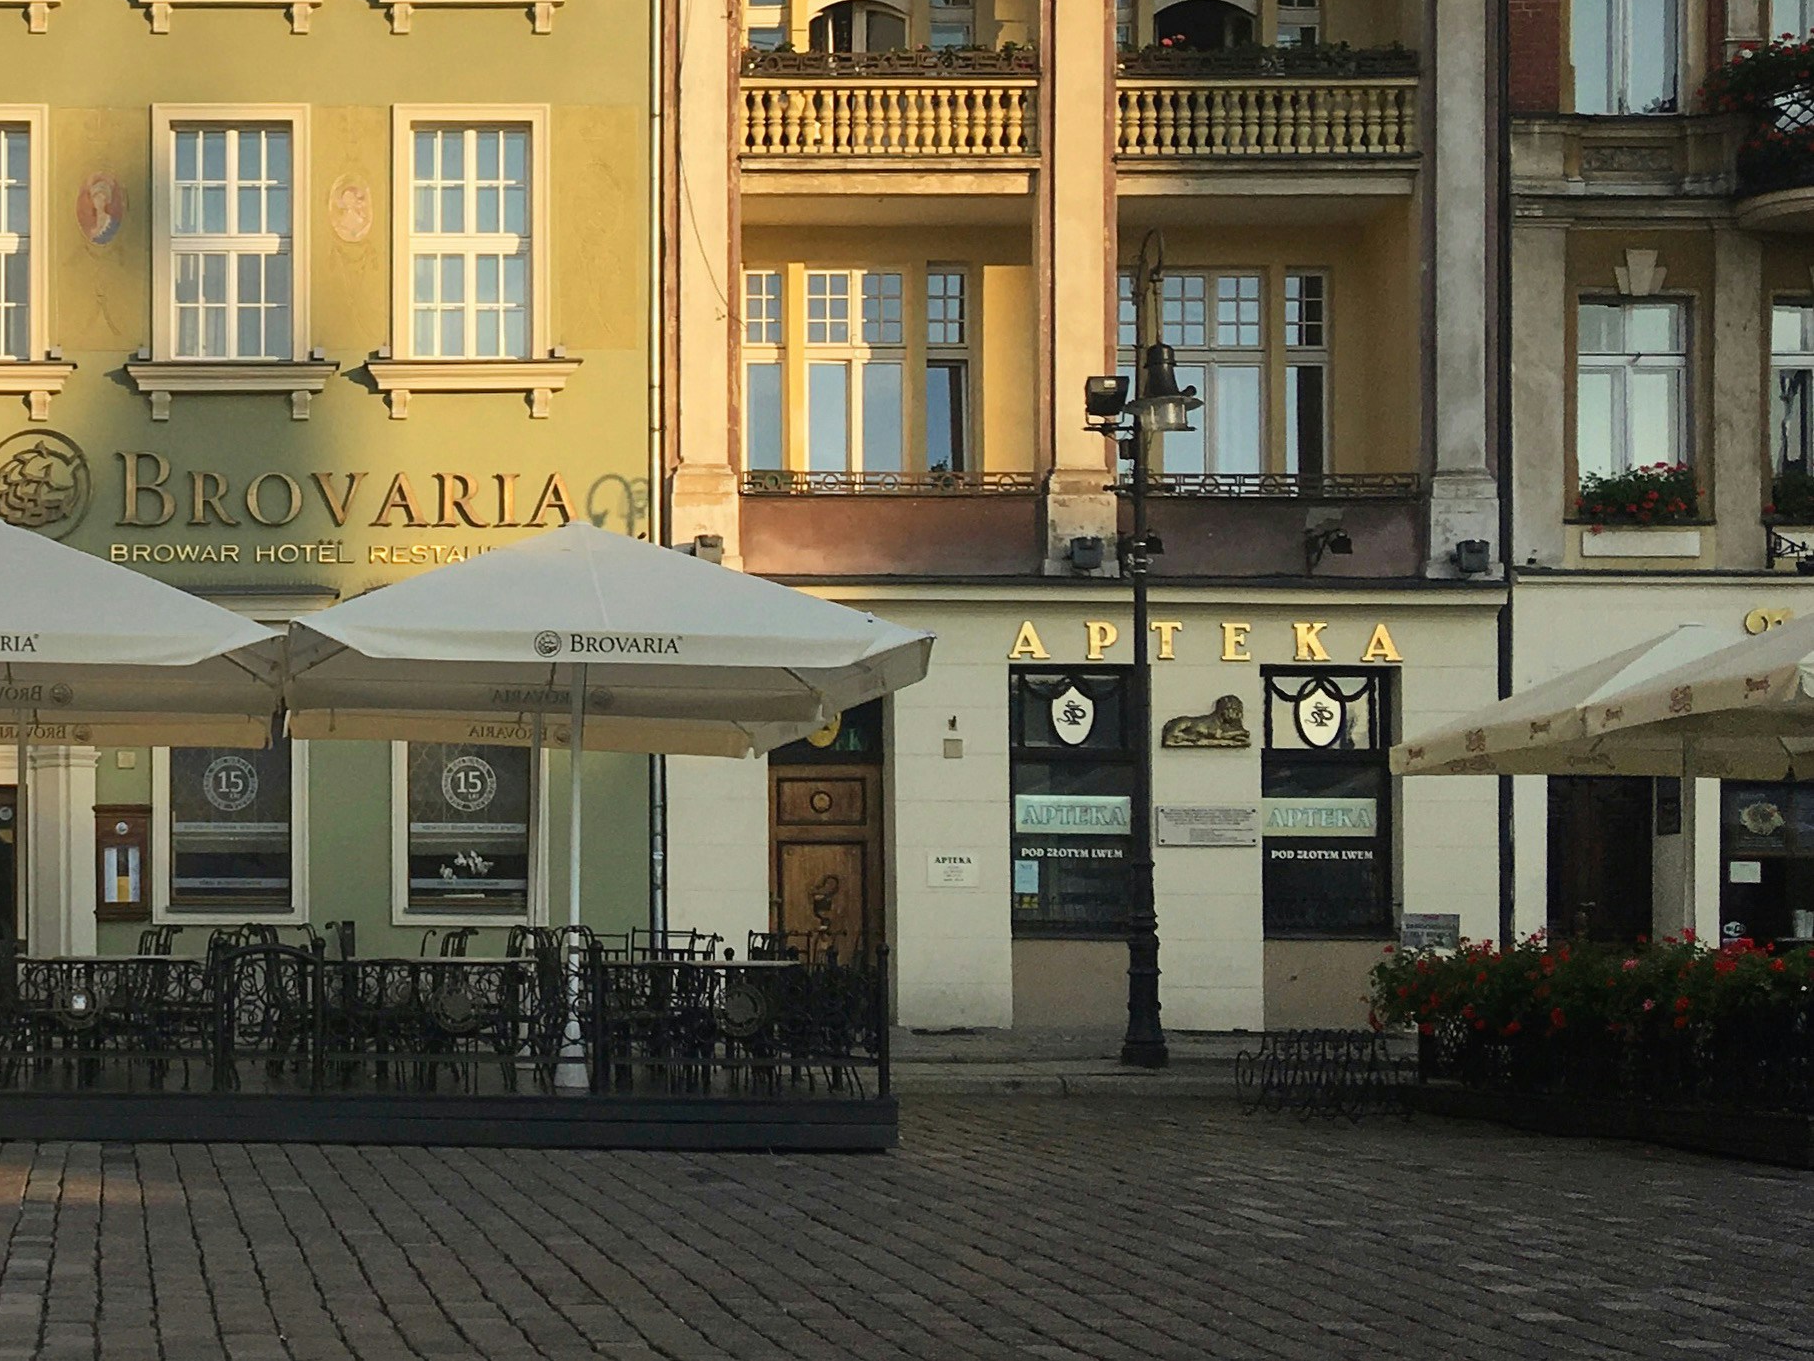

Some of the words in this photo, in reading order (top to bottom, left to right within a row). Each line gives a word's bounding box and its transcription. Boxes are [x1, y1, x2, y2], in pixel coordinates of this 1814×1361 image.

[114, 450, 582, 529] BROVARIA
[110, 543, 240, 564] BROWAR
[256, 542, 355, 565] HOTEL
[368, 544, 498, 564] RESTAU
[569, 633, 680, 654] BROVARIA
[1007, 620, 1404, 662] APTEKA
[217, 770, 244, 793] 15
[456, 771, 482, 793] 15
[1021, 804, 1127, 827] APTEKA
[1267, 807, 1374, 829] APTEKA
[934, 856, 972, 865] APTEKA
[1020, 847, 1045, 858] POD
[1046, 847, 1089, 859] ZŁOTYM
[1091, 848, 1124, 859] LWEM
[1271, 849, 1294, 860] POD
[1297, 850, 1340, 861] ZŁOTYM
[1341, 850, 1374, 861] LWEM
